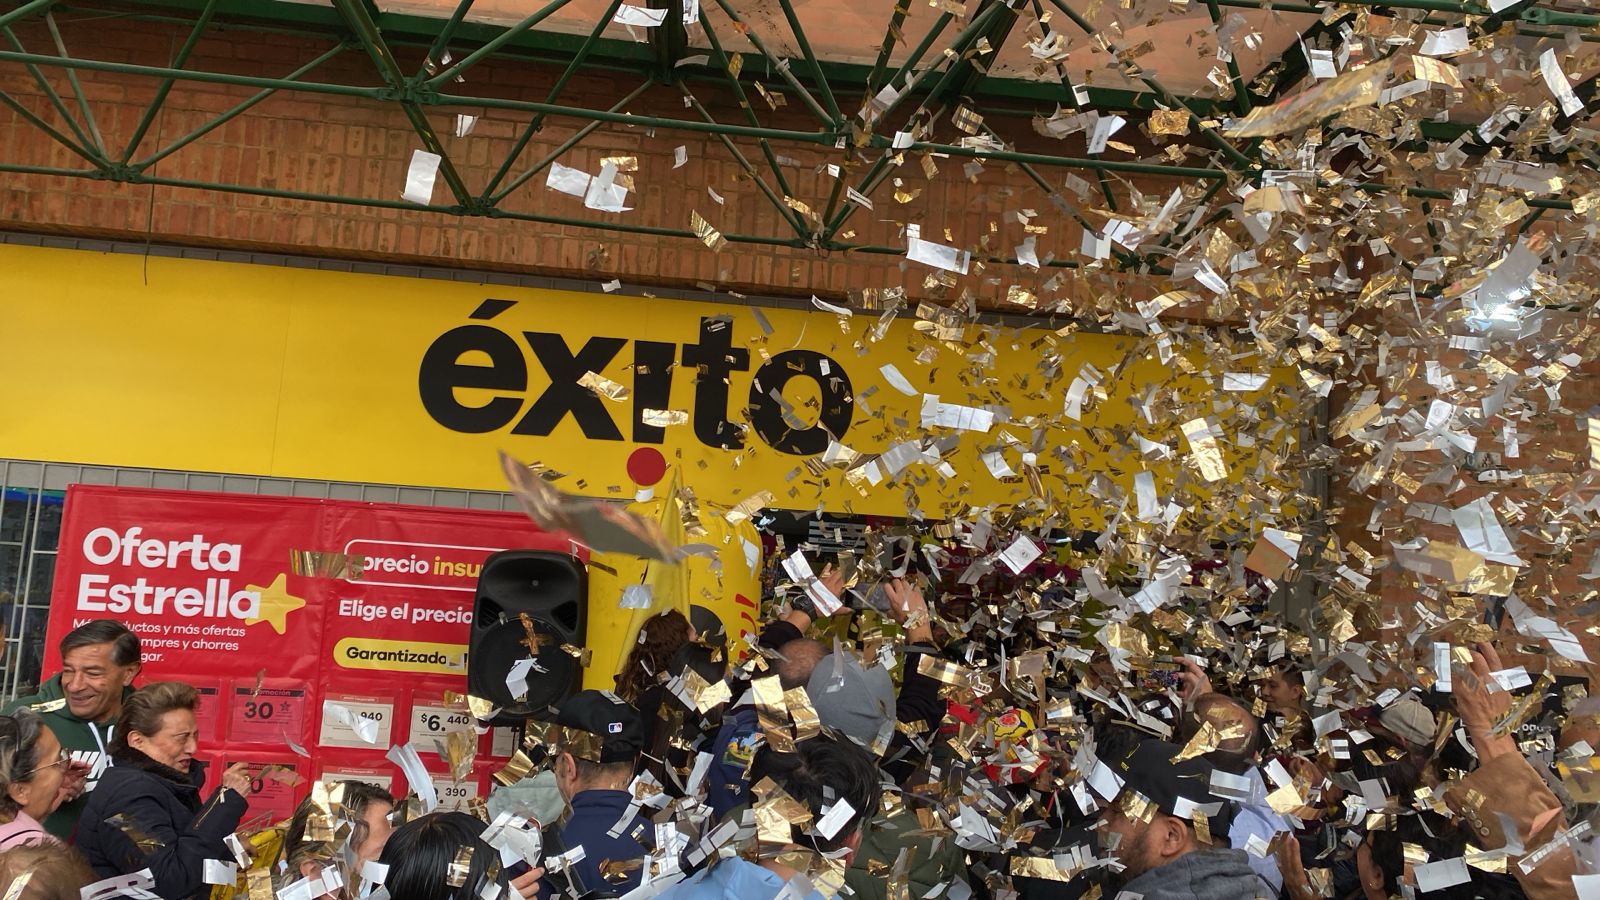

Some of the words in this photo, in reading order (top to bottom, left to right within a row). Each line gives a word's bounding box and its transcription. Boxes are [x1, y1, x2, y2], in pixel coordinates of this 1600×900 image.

[419, 298, 854, 486] éxito
[82, 526, 241, 572] Oferta
[433, 556, 483, 578] insu
[76, 573, 261, 620] Estrella
[338, 599, 387, 621] Elige
[390, 603, 409, 620] el
[411, 606, 473, 624] precio
[163, 625, 171, 635] y
[173, 623, 200, 635] más
[202, 623, 246, 637] ofertas
[140, 638, 180, 649] mpres
[182, 639, 190, 650] y
[192, 638, 239, 651] ahorres
[140, 651, 164, 662] gar.
[346, 646, 446, 665] Garantizado
[244, 701, 273, 720] 30
